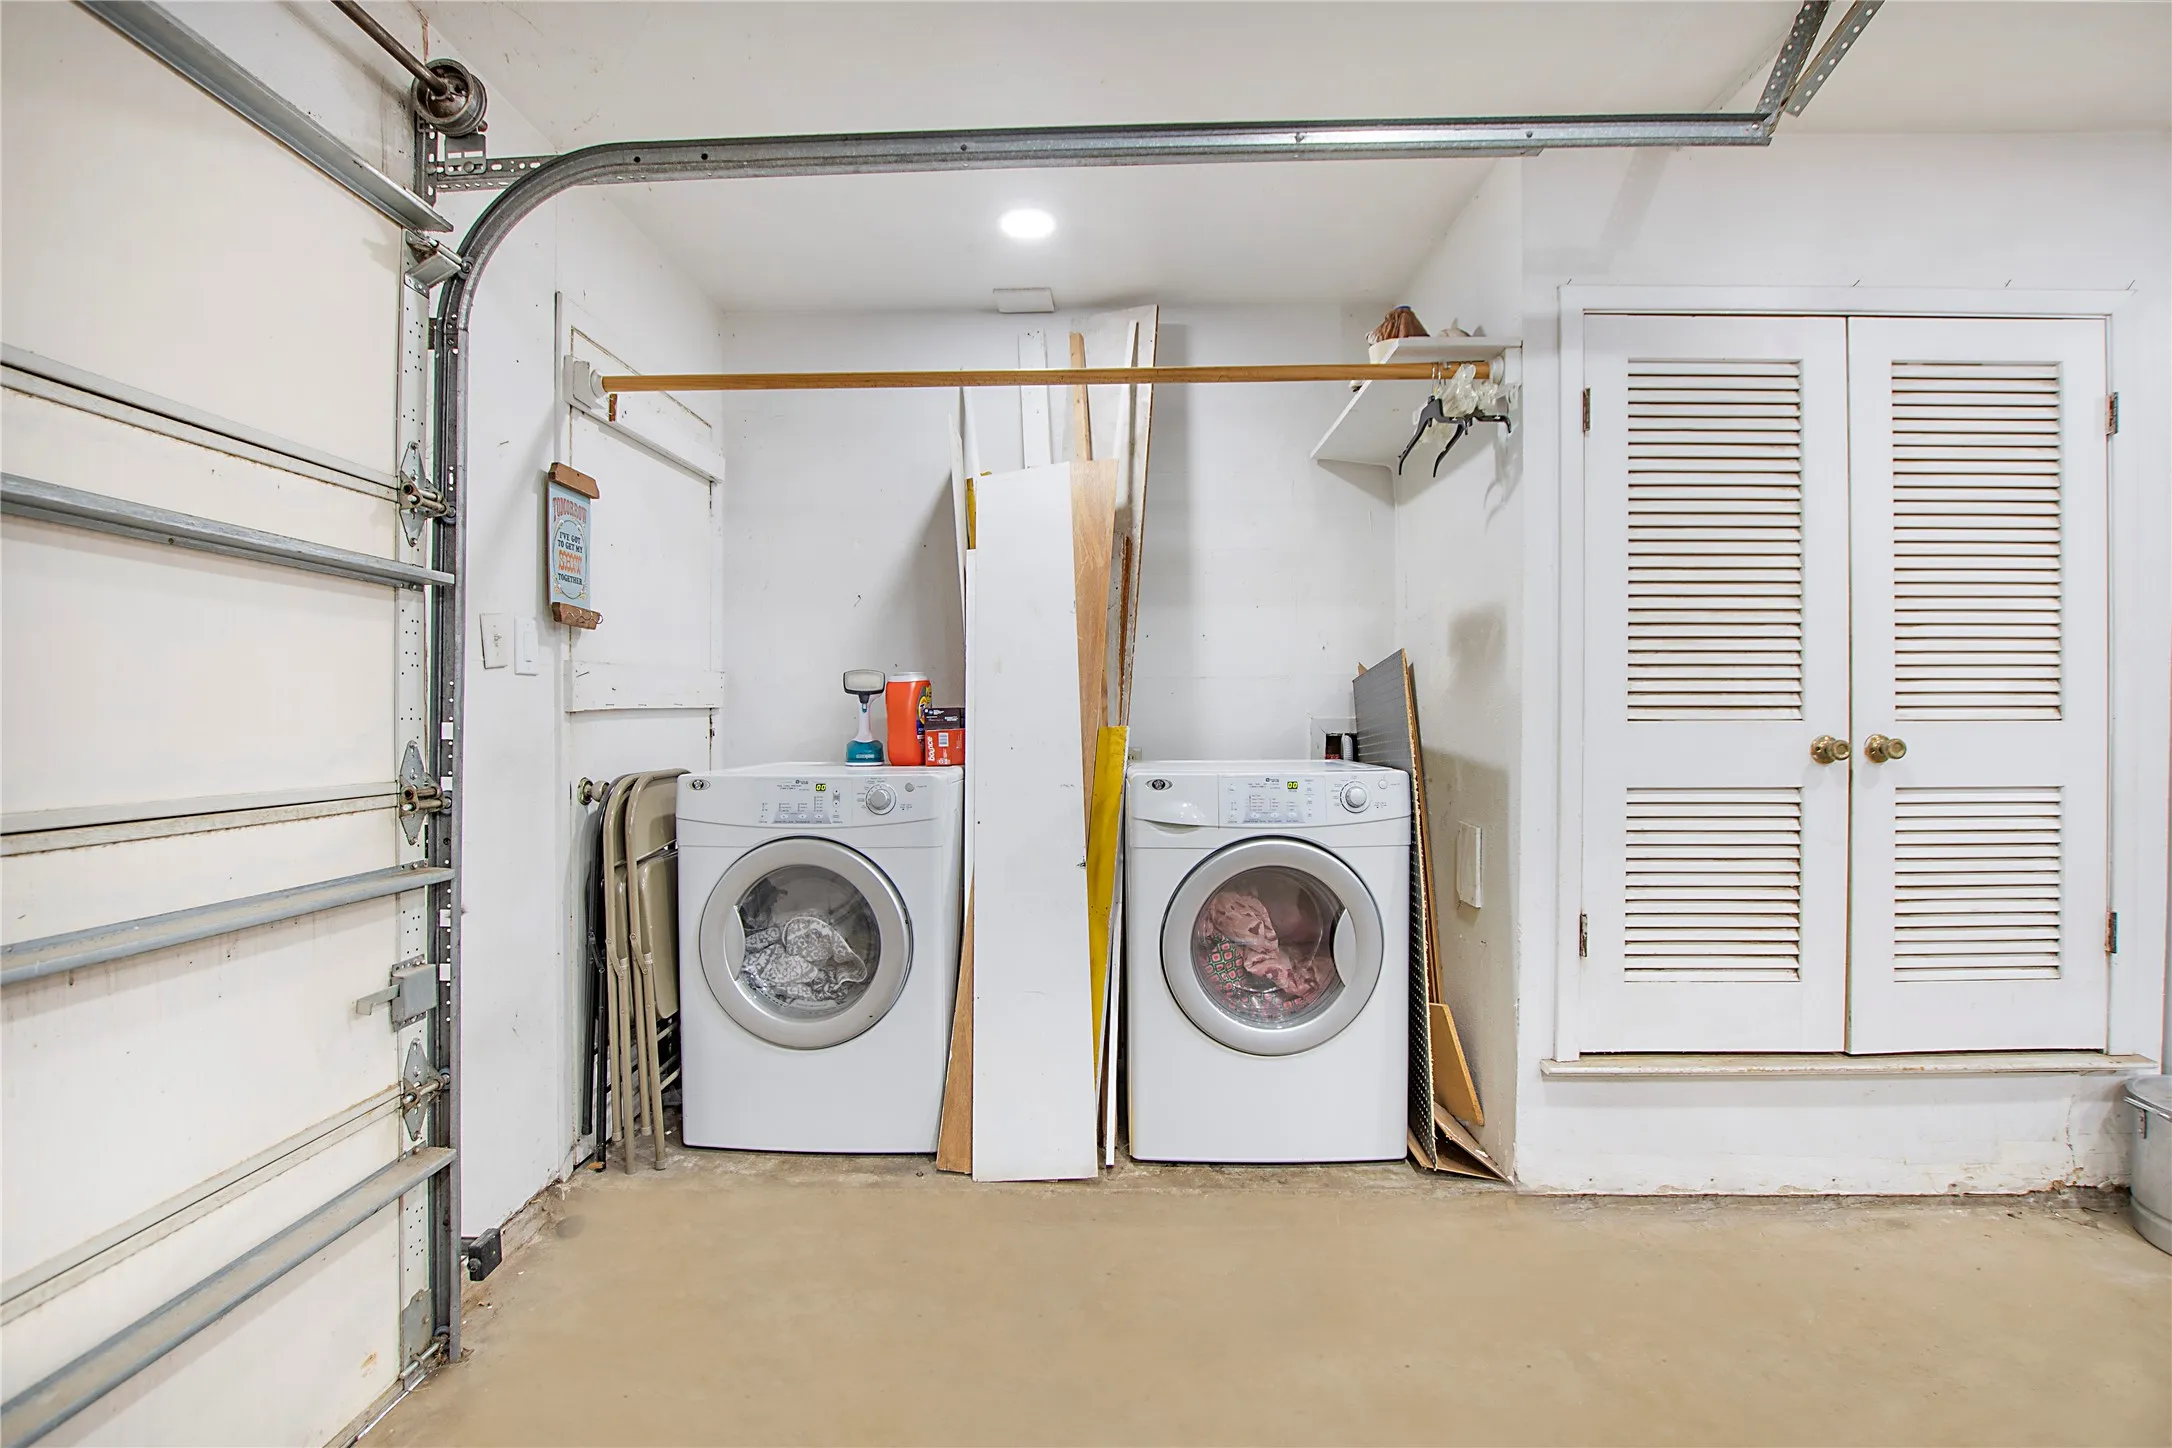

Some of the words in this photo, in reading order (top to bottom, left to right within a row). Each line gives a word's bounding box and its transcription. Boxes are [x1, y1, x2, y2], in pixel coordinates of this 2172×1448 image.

[553, 497, 587, 525] TOMORROW
[560, 532, 570, 542] I'VE
[571, 535, 581, 545] GOT
[558, 540, 564, 548] TO
[565, 542, 575, 551] GET
[575, 545, 583, 553] MY
[558, 573, 583, 586] TOGETHER
[927, 736, 936, 762] bounce
